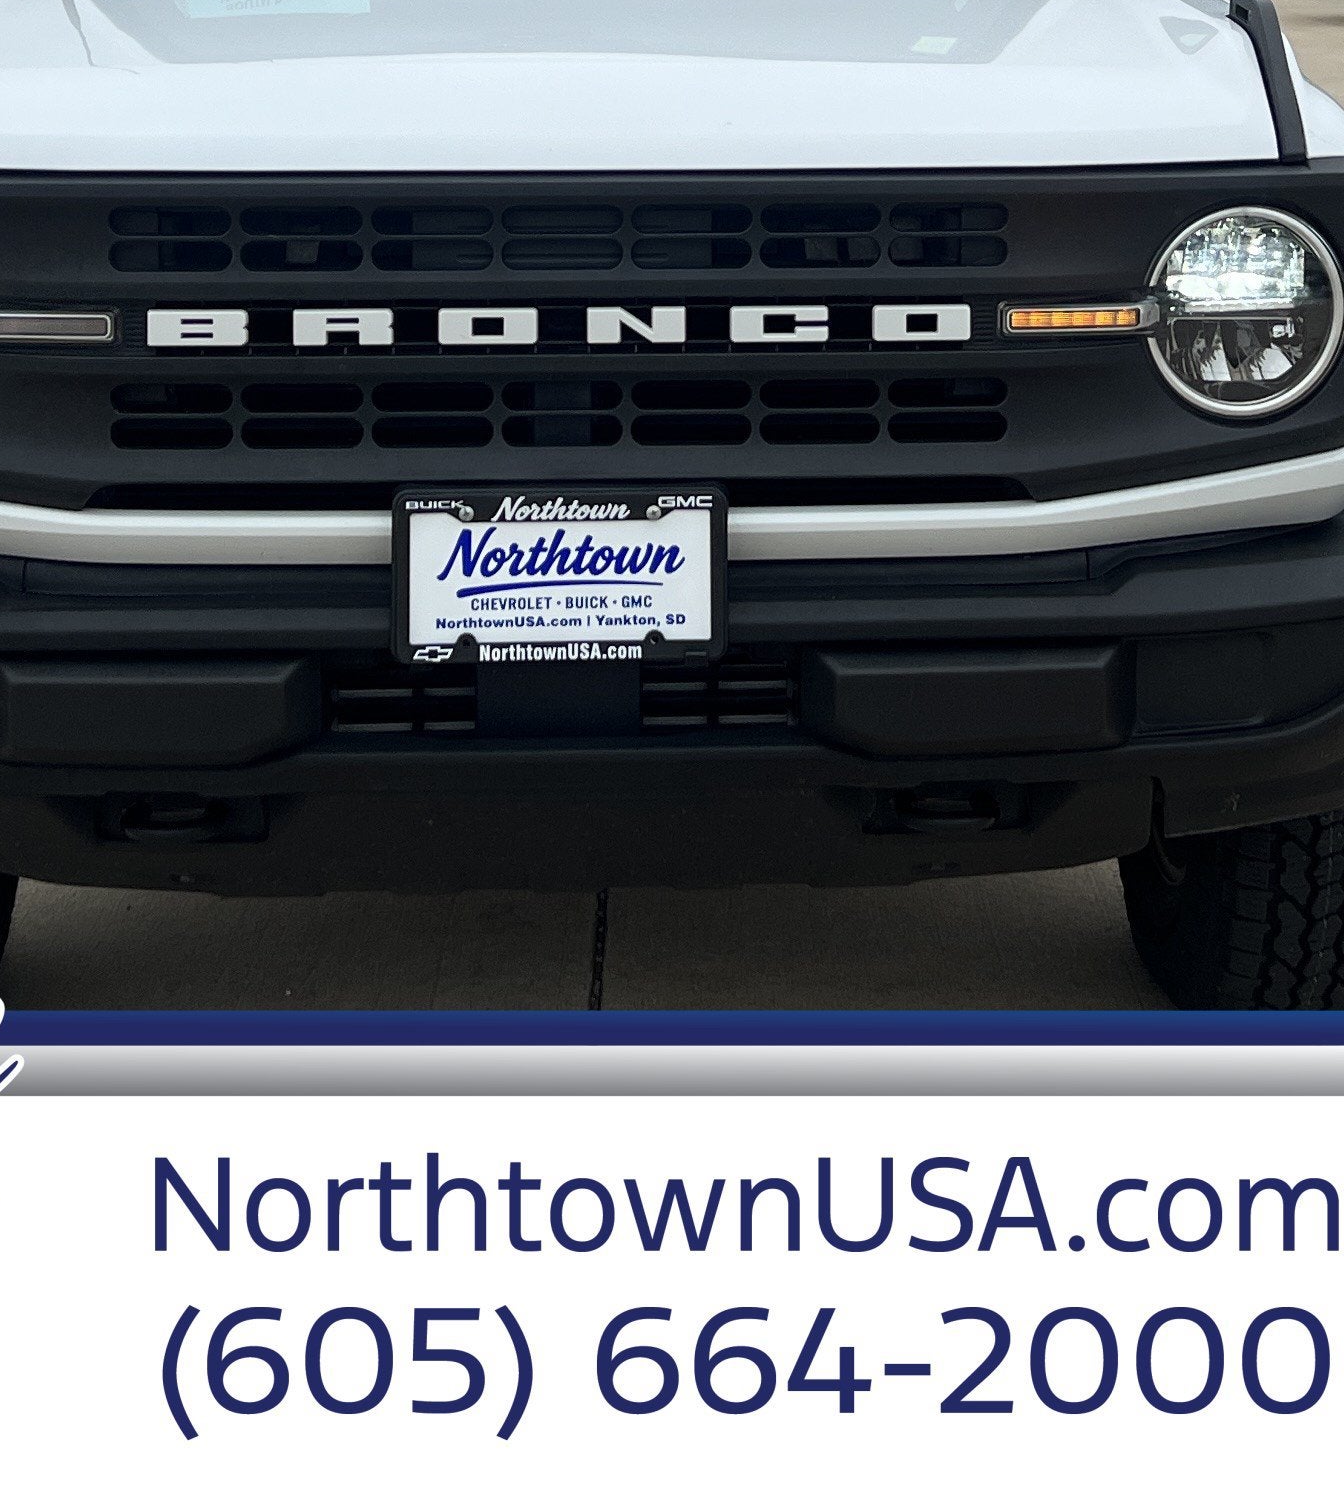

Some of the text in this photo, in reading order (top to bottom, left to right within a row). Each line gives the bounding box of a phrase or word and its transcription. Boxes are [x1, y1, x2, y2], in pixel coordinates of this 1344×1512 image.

[146, 303, 972, 347] BRONCO
[405, 499, 464, 510] BUICK
[490, 495, 631, 523] Northtown
[657, 495, 713, 508] GMC
[436, 526, 686, 581] Northtown
[470, 595, 654, 611] CHEVROLET BUICK GMC
[435, 614, 687, 630] NorthtownUSA.com Yankton, SD
[479, 643, 643, 662] NorthtownUSA.com
